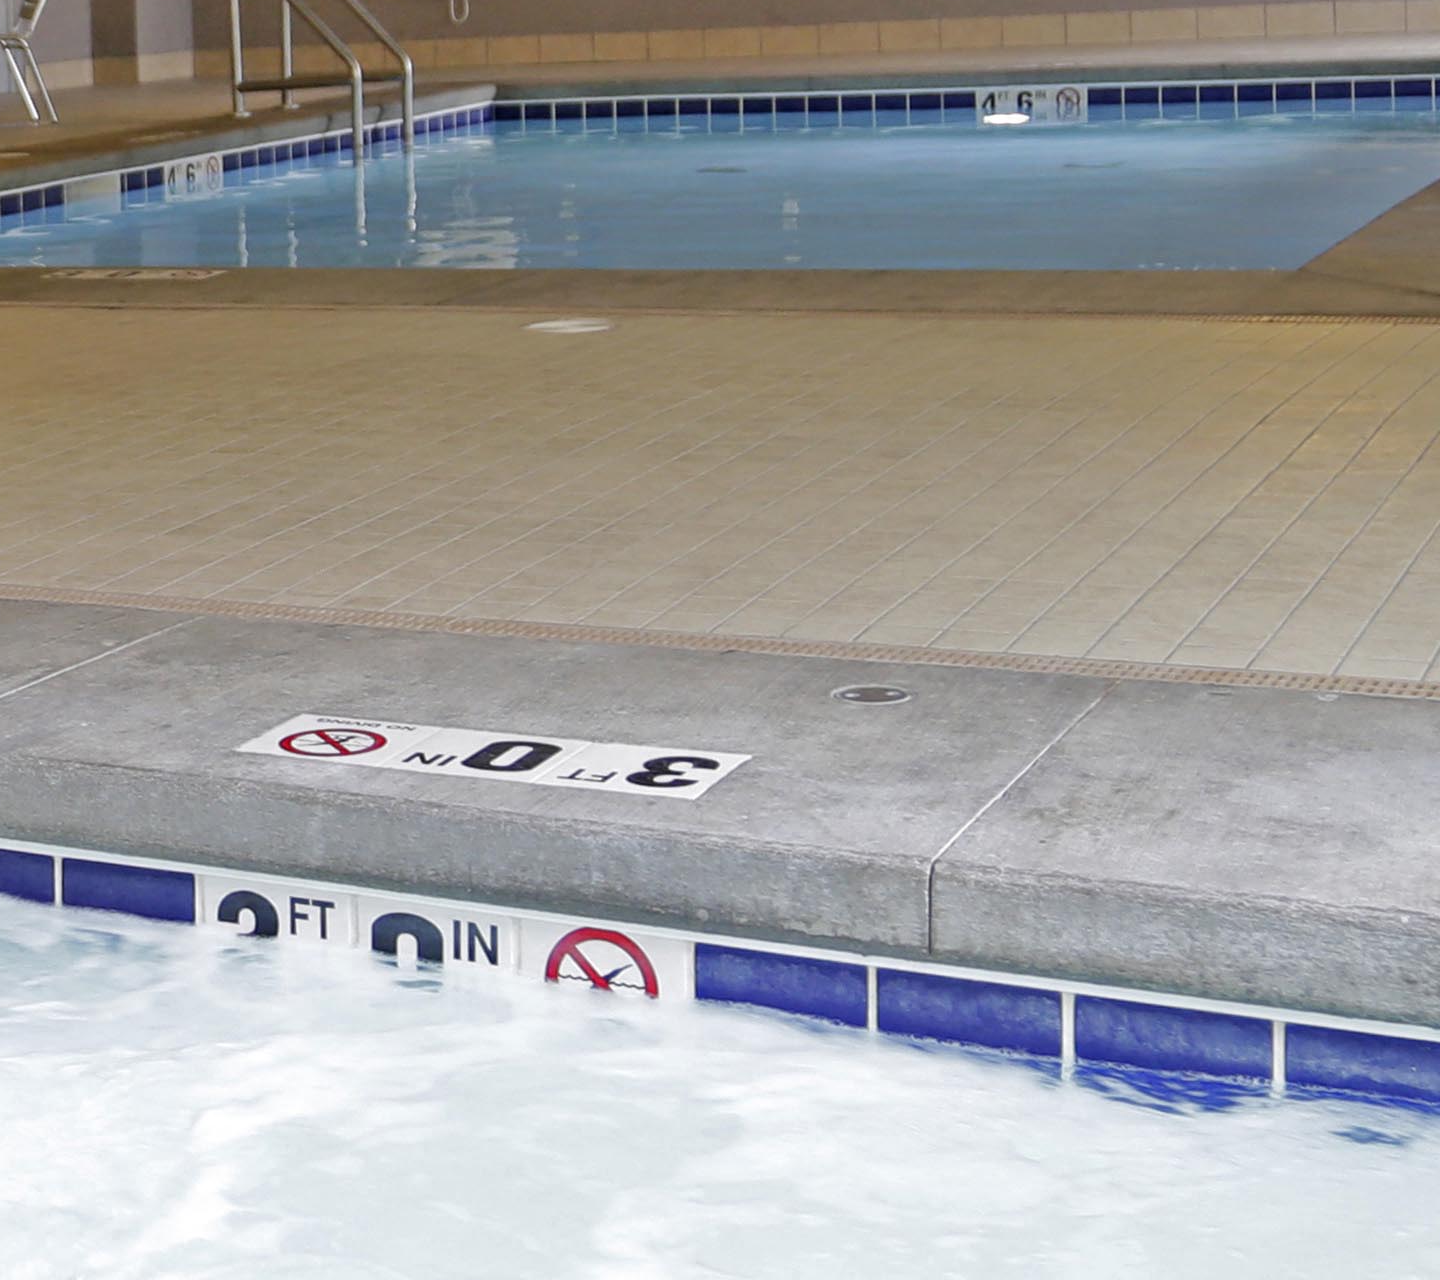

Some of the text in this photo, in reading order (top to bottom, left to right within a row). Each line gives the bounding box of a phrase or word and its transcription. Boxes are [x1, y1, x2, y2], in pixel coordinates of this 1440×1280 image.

[402, 740, 720, 788] 3 FT 0 IN
[289, 895, 335, 939] FT
[453, 919, 498, 966] IN
